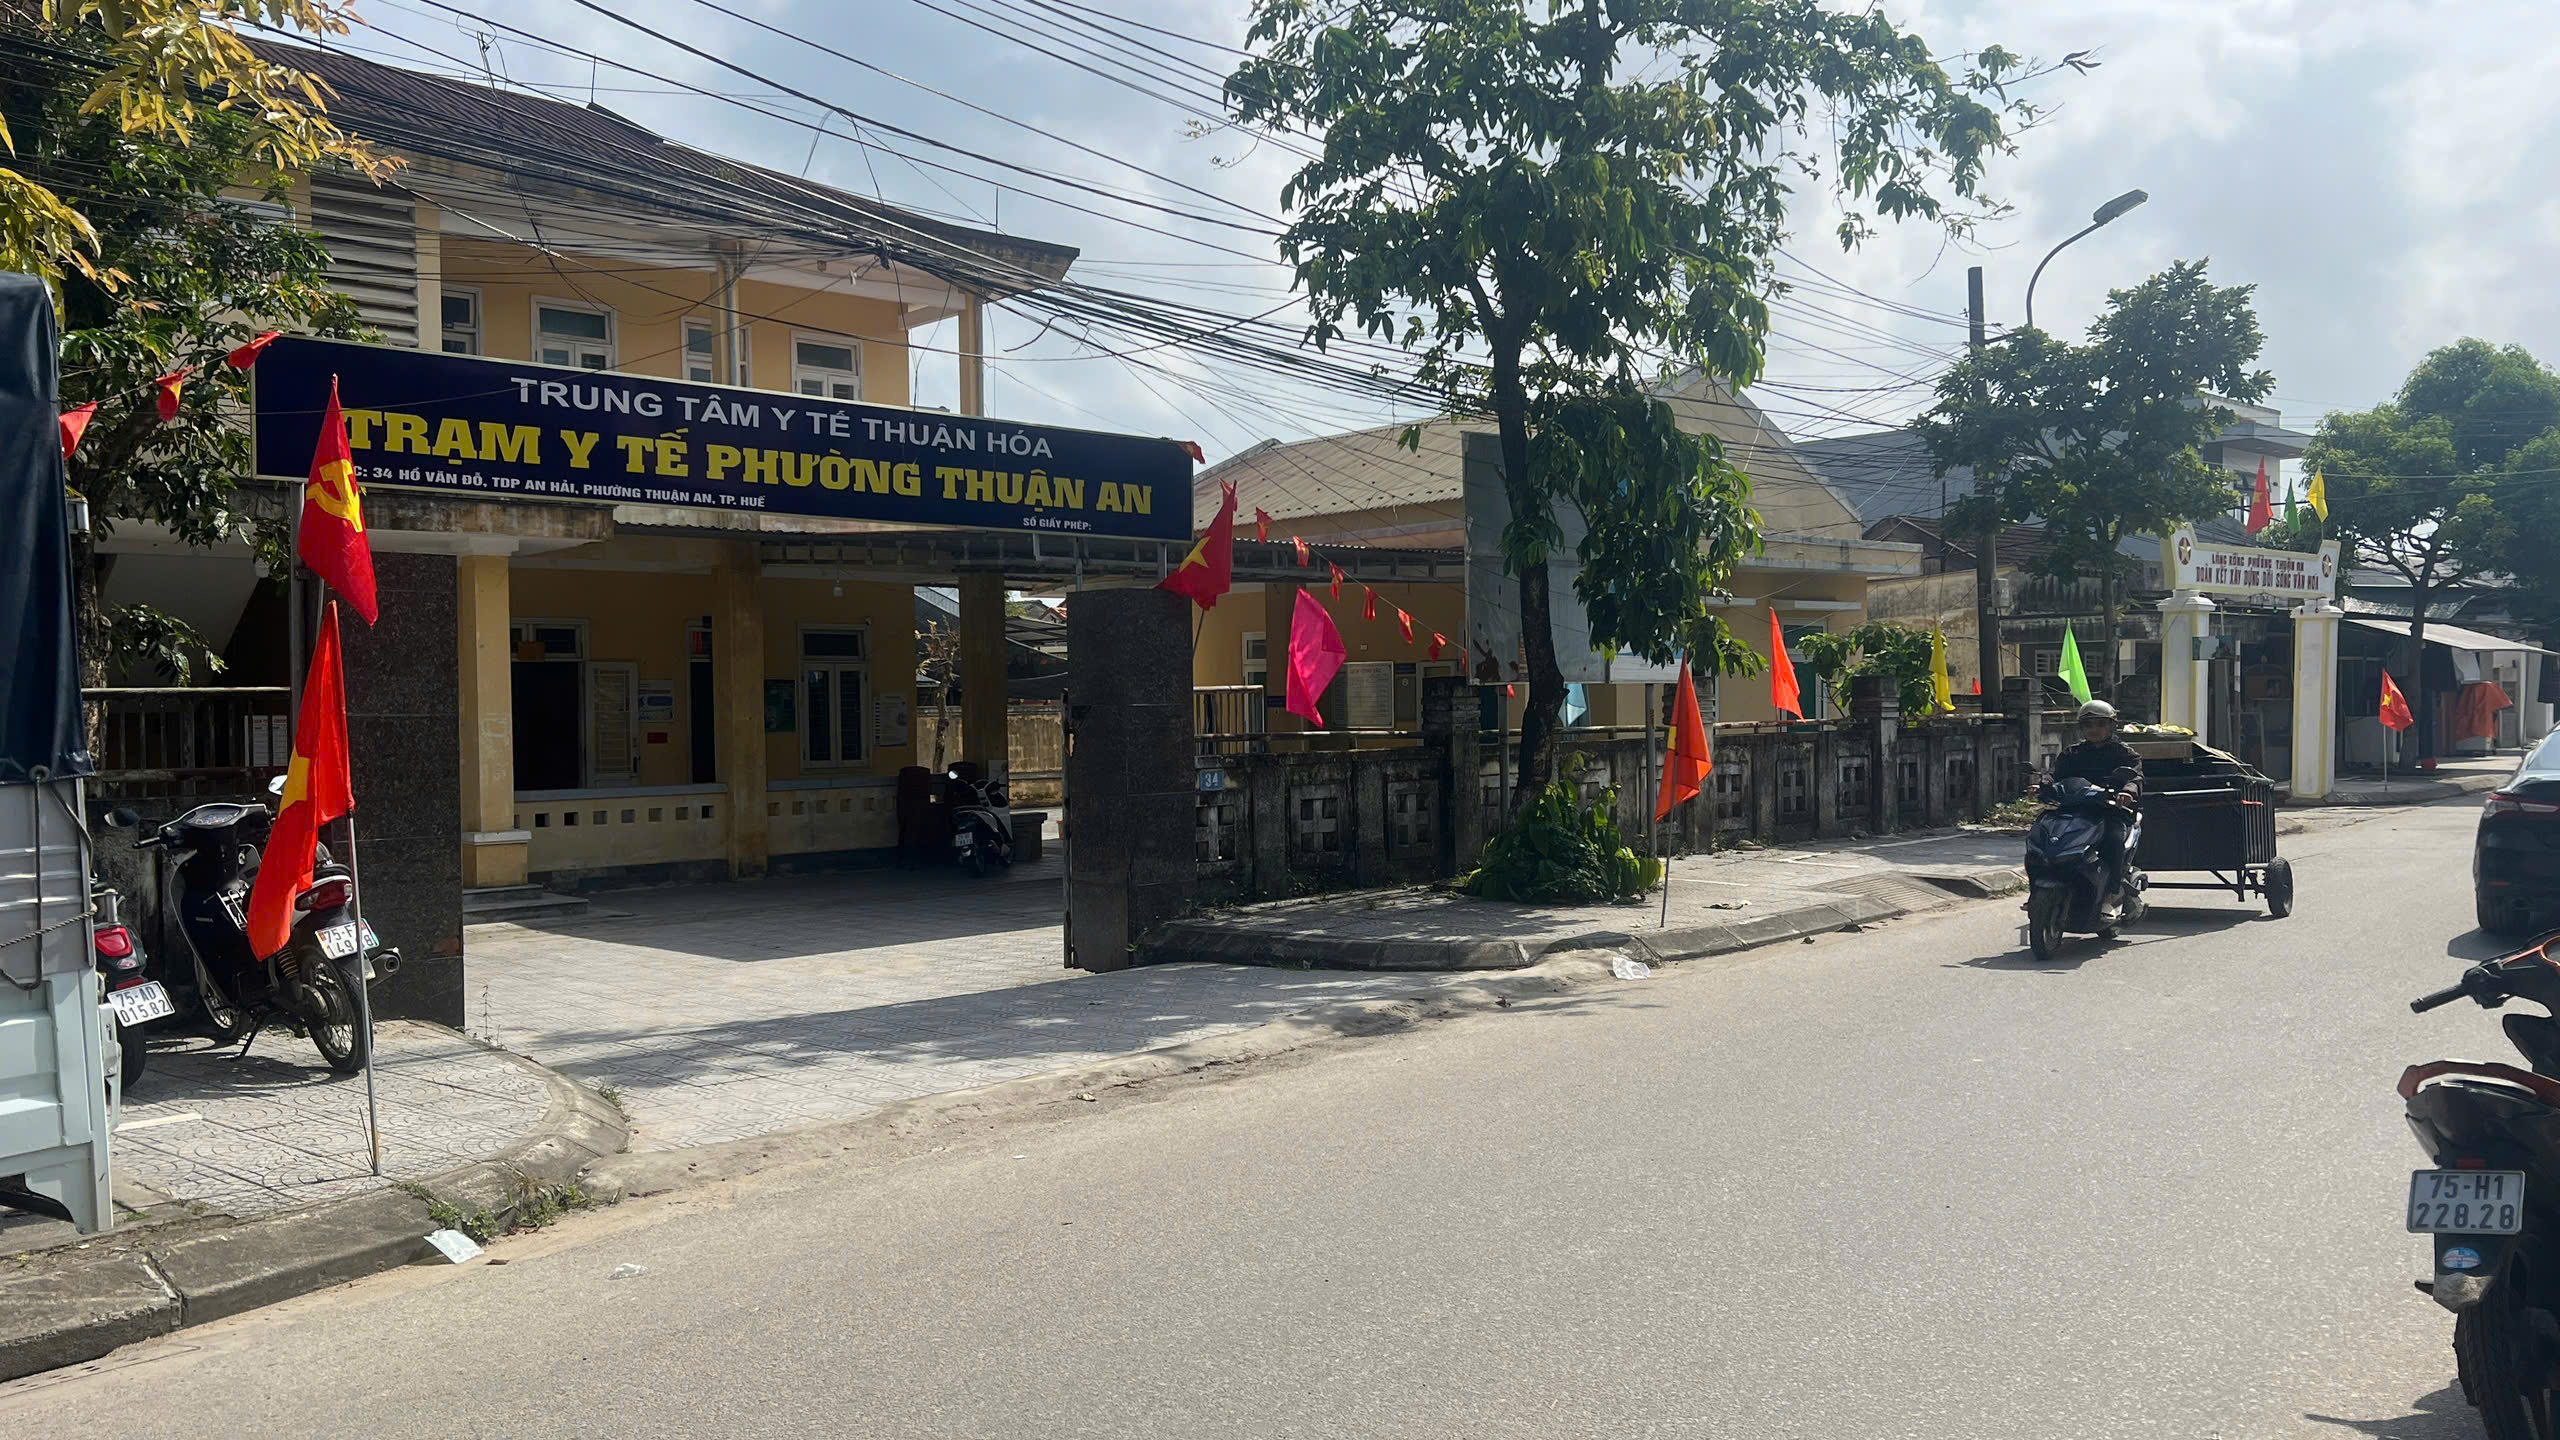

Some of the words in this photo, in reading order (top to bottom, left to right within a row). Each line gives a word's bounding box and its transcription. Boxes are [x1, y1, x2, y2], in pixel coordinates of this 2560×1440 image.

[511, 377, 663, 417] TRUNG
[676, 393, 760, 428] TÂM
[771, 406, 797, 431] Y
[805, 409, 851, 438] TẾ
[861, 417, 976, 453] THUẬN
[987, 430, 1053, 459] HÓA
[342, 409, 541, 465] TRẠM
[560, 429, 600, 469] Y
[617, 428, 689, 477] TẾ
[706, 443, 921, 497] PHƯỜNG
[935, 466, 1085, 513] THUẬN
[1096, 481, 1153, 515] AN
[372, 467, 393, 479] 34
[425, 470, 458, 485] VĂN
[491, 476, 521, 489] TDP
[524, 479, 546, 491] AN
[550, 479, 579, 495] HẢI,
[583, 483, 641, 498] PHƯỜNG
[645, 489, 690, 503] THUẬN
[693, 492, 716, 505] AN,
[719, 494, 737, 506] TP.
[740, 495, 766, 508] HUẾ
[1022, 515, 1037, 527] SỐ
[1039, 517, 1062, 529] GIẤY
[1205, 772, 1219, 787] 34
[119, 999, 170, 1023] 015.82
[2430, 1175, 2504, 1200] 75-H1
[2414, 1203, 2515, 1230] 228.28
